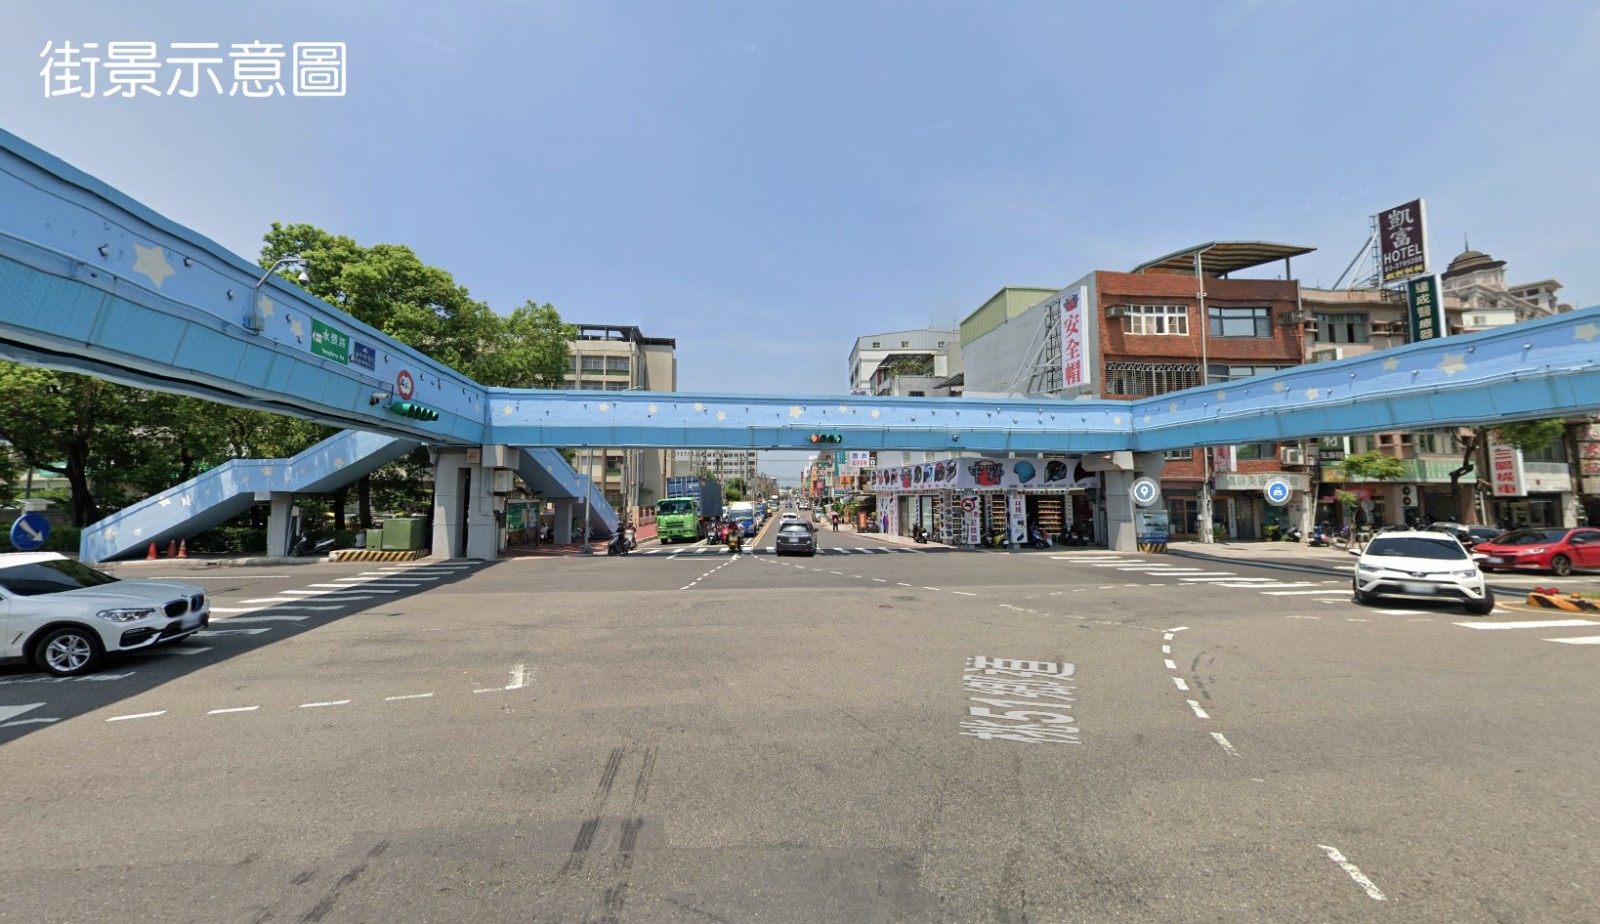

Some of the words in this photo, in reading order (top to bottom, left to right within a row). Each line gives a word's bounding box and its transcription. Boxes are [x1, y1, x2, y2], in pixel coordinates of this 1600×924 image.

[1388, 208, 1414, 249] 凱富
[1384, 245, 1422, 265] HOTEL
[322, 329, 346, 349] 永豐路
[1063, 314, 1081, 385] 安全帽
